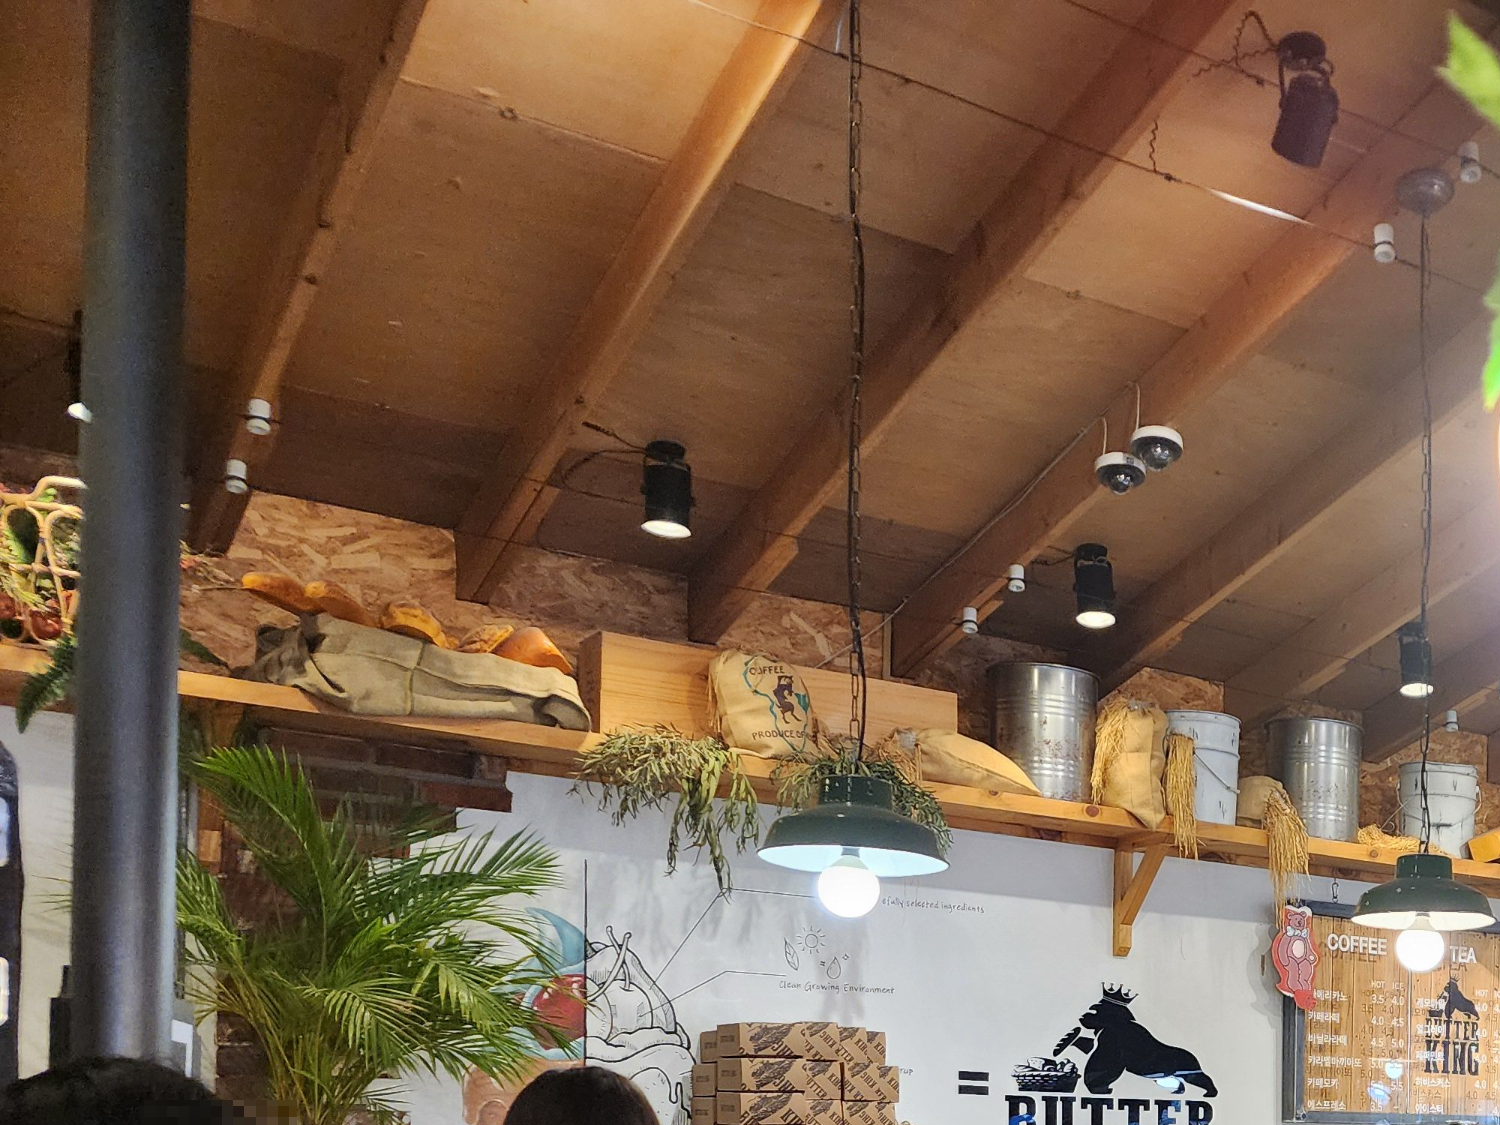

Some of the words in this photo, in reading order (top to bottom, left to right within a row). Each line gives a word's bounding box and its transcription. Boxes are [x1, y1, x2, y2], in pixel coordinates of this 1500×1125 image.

[752, 730, 795, 740] PRODUCE
[882, 897, 904, 908] efully
[906, 899, 939, 909] selected
[941, 901, 985, 914] ingredients
[1327, 933, 1388, 955] COFFEE
[1450, 945, 1477, 964] TEA
[779, 980, 801, 990] Clean
[804, 982, 840, 994] Growing
[843, 983, 895, 994] Environment
[1371, 981, 1385, 989] HOT
[1392, 982, 1404, 990] ICE
[1475, 989, 1489, 997] HOT
[1371, 994, 1385, 1004] 3.5
[1391, 995, 1405, 1006] 4.0
[1371, 1016, 1385, 1026] 4.0
[1390, 1017, 1405, 1027] 4.5
[1425, 1018, 1479, 1041] BUTTER
[1370, 1037, 1384, 1047] 4.5
[1391, 1038, 1405, 1048] 5.0
[1424, 1040, 1479, 1076] KING
[1390, 1081, 1404, 1091] 5.5
[1474, 1080, 1487, 1089] 4.0
[1307, 1099, 1346, 1111] 에스프레소
[1370, 1101, 1383, 1112] 3.5
